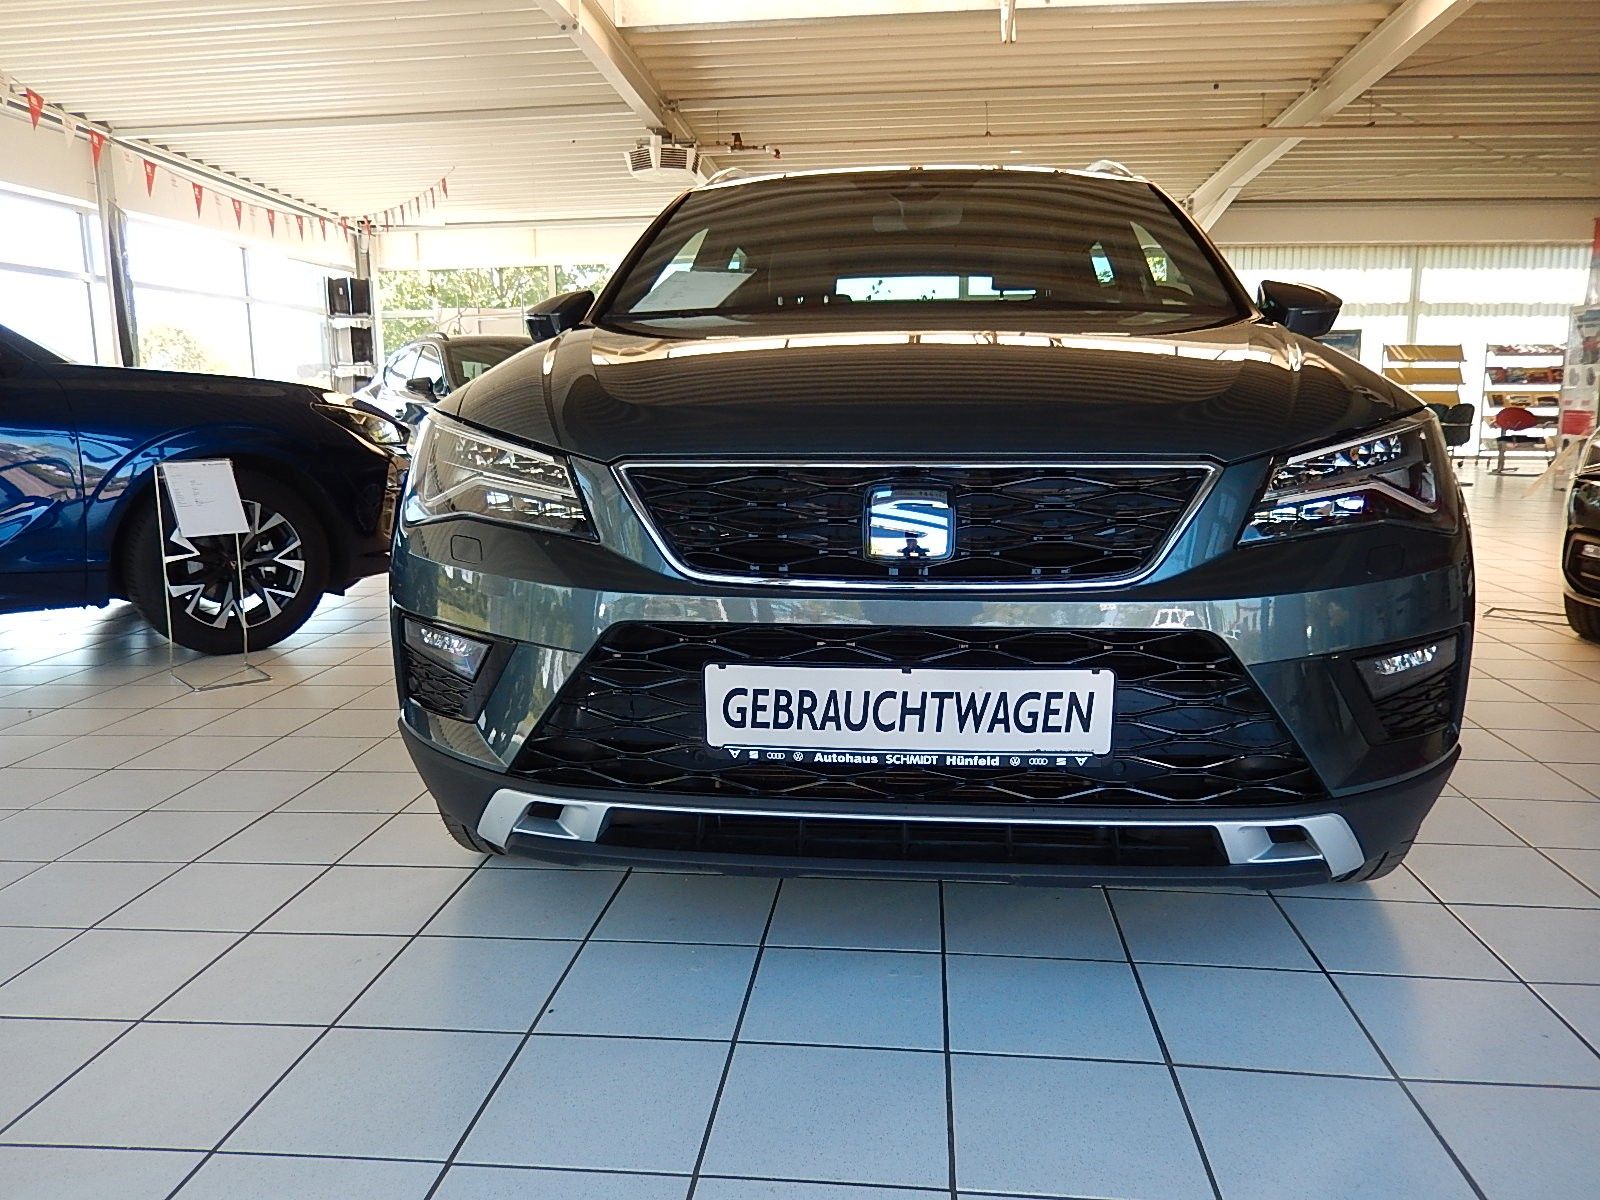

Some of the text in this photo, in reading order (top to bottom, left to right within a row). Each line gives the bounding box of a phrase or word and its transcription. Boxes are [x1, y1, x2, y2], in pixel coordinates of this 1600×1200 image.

[722, 688, 1095, 733] GEBRAUCHTWAGEN
[813, 752, 1000, 767] Autohaus SCHMIDT Hünfeld
